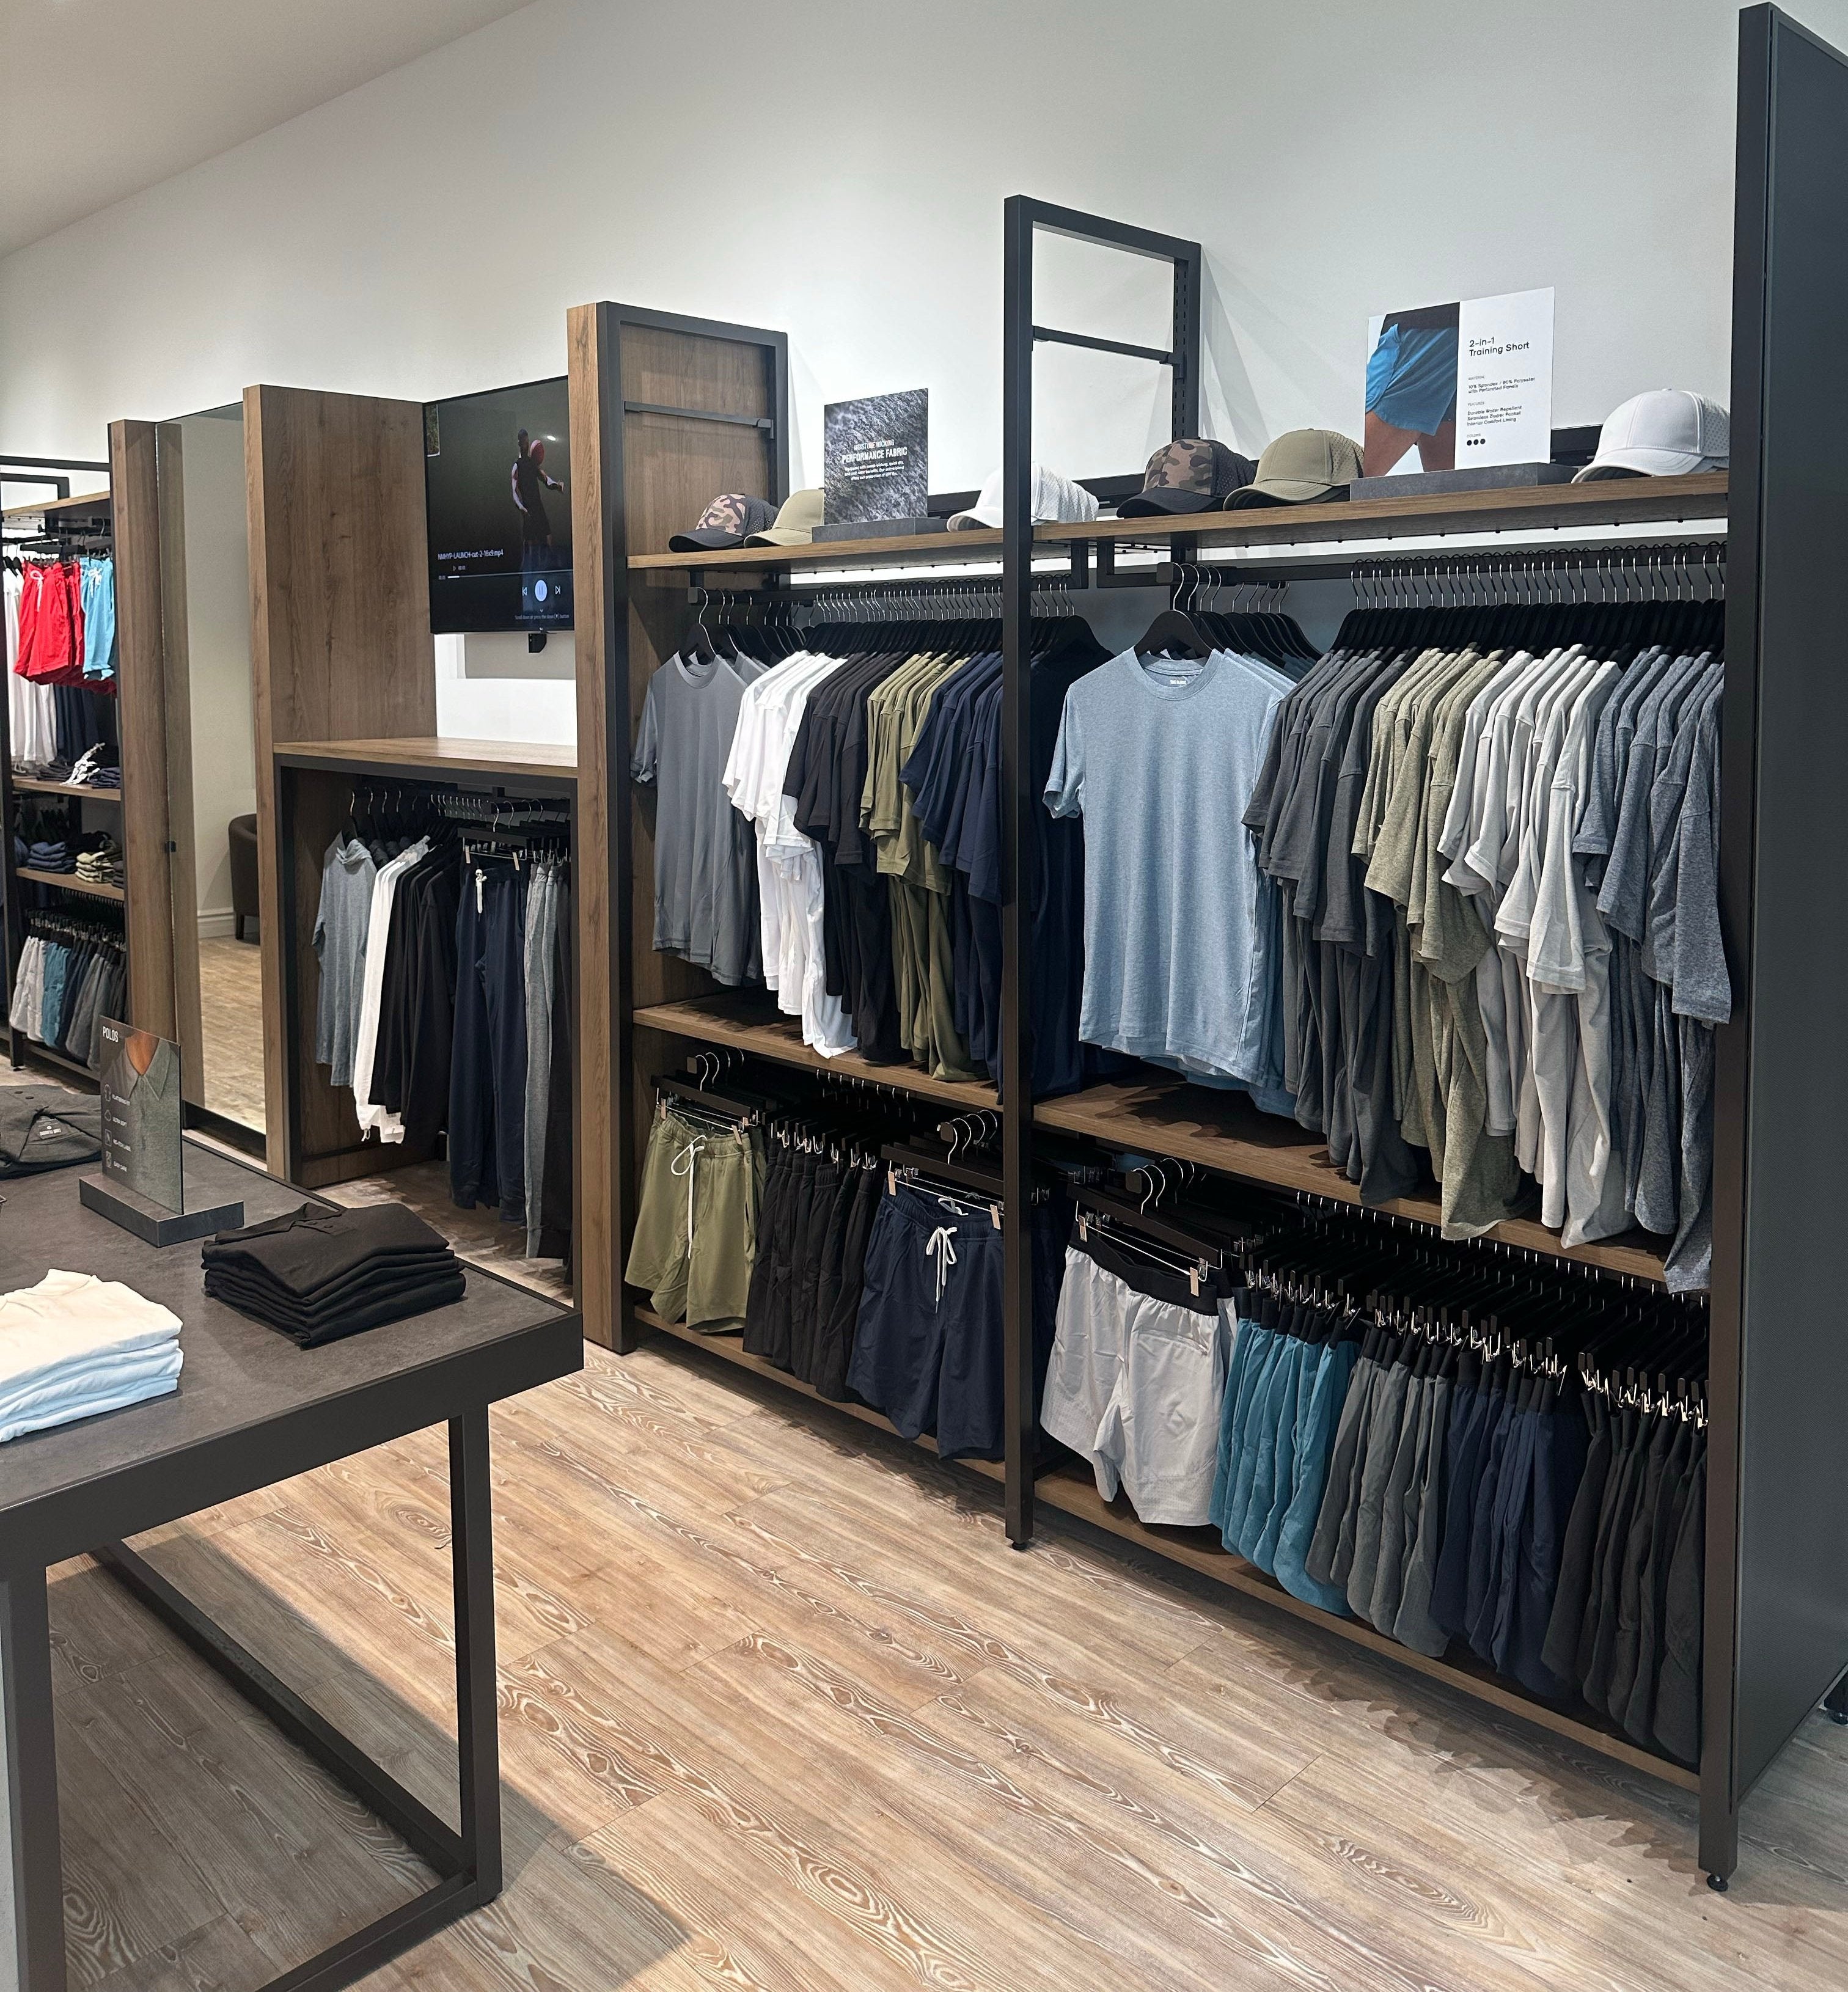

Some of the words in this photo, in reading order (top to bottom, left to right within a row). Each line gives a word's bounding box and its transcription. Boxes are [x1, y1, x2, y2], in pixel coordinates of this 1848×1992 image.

[1469, 337, 1494, 347] 2-in-1
[1469, 346, 1503, 356] Training
[1506, 342, 1530, 351] Short
[842, 450, 884, 464] PERFORMANCE
[886, 447, 908, 458] FABRIC
[103, 1026, 119, 1042] POLOS
